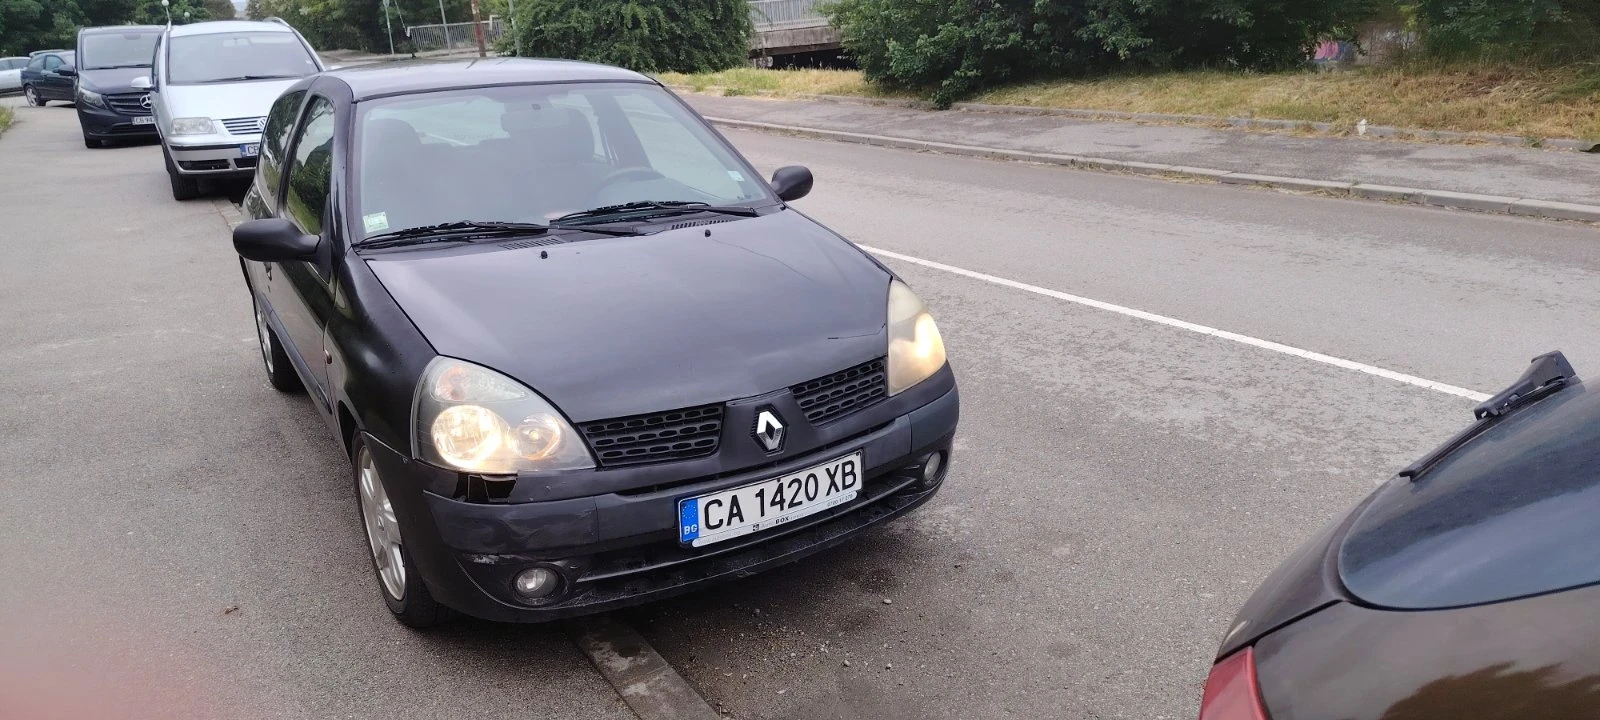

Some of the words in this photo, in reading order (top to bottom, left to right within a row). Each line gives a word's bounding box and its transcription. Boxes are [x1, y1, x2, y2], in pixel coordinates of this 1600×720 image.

[704, 495, 745, 531] CA
[755, 472, 819, 518] 1420
[825, 460, 857, 497] XB
[775, 516, 789, 525] BOX
[684, 524, 698, 535] BG
